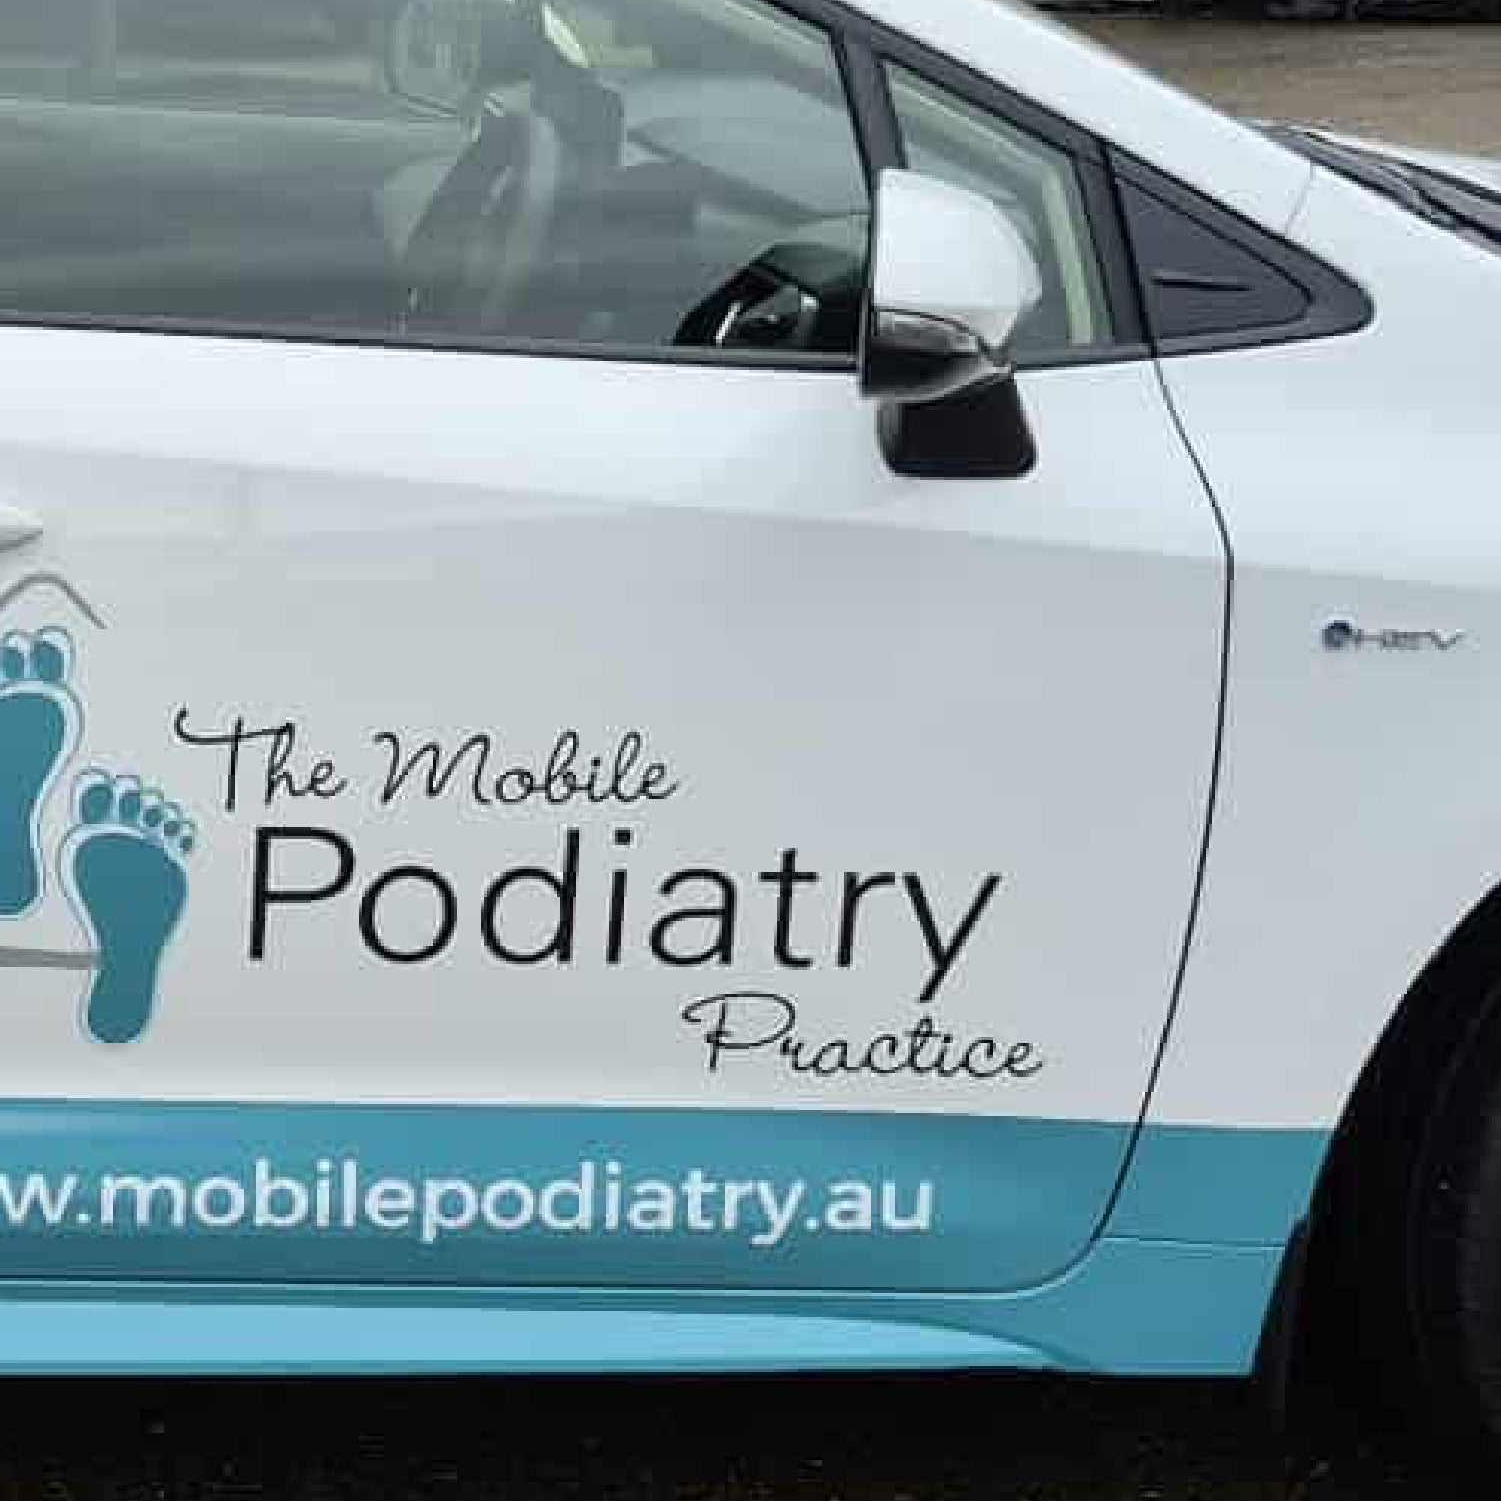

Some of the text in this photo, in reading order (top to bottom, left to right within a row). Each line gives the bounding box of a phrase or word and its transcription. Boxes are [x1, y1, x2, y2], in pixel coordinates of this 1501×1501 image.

[174, 706, 680, 813] The Mobile
[248, 825, 1004, 1001] Podiatry
[681, 992, 1045, 1079] Practice
